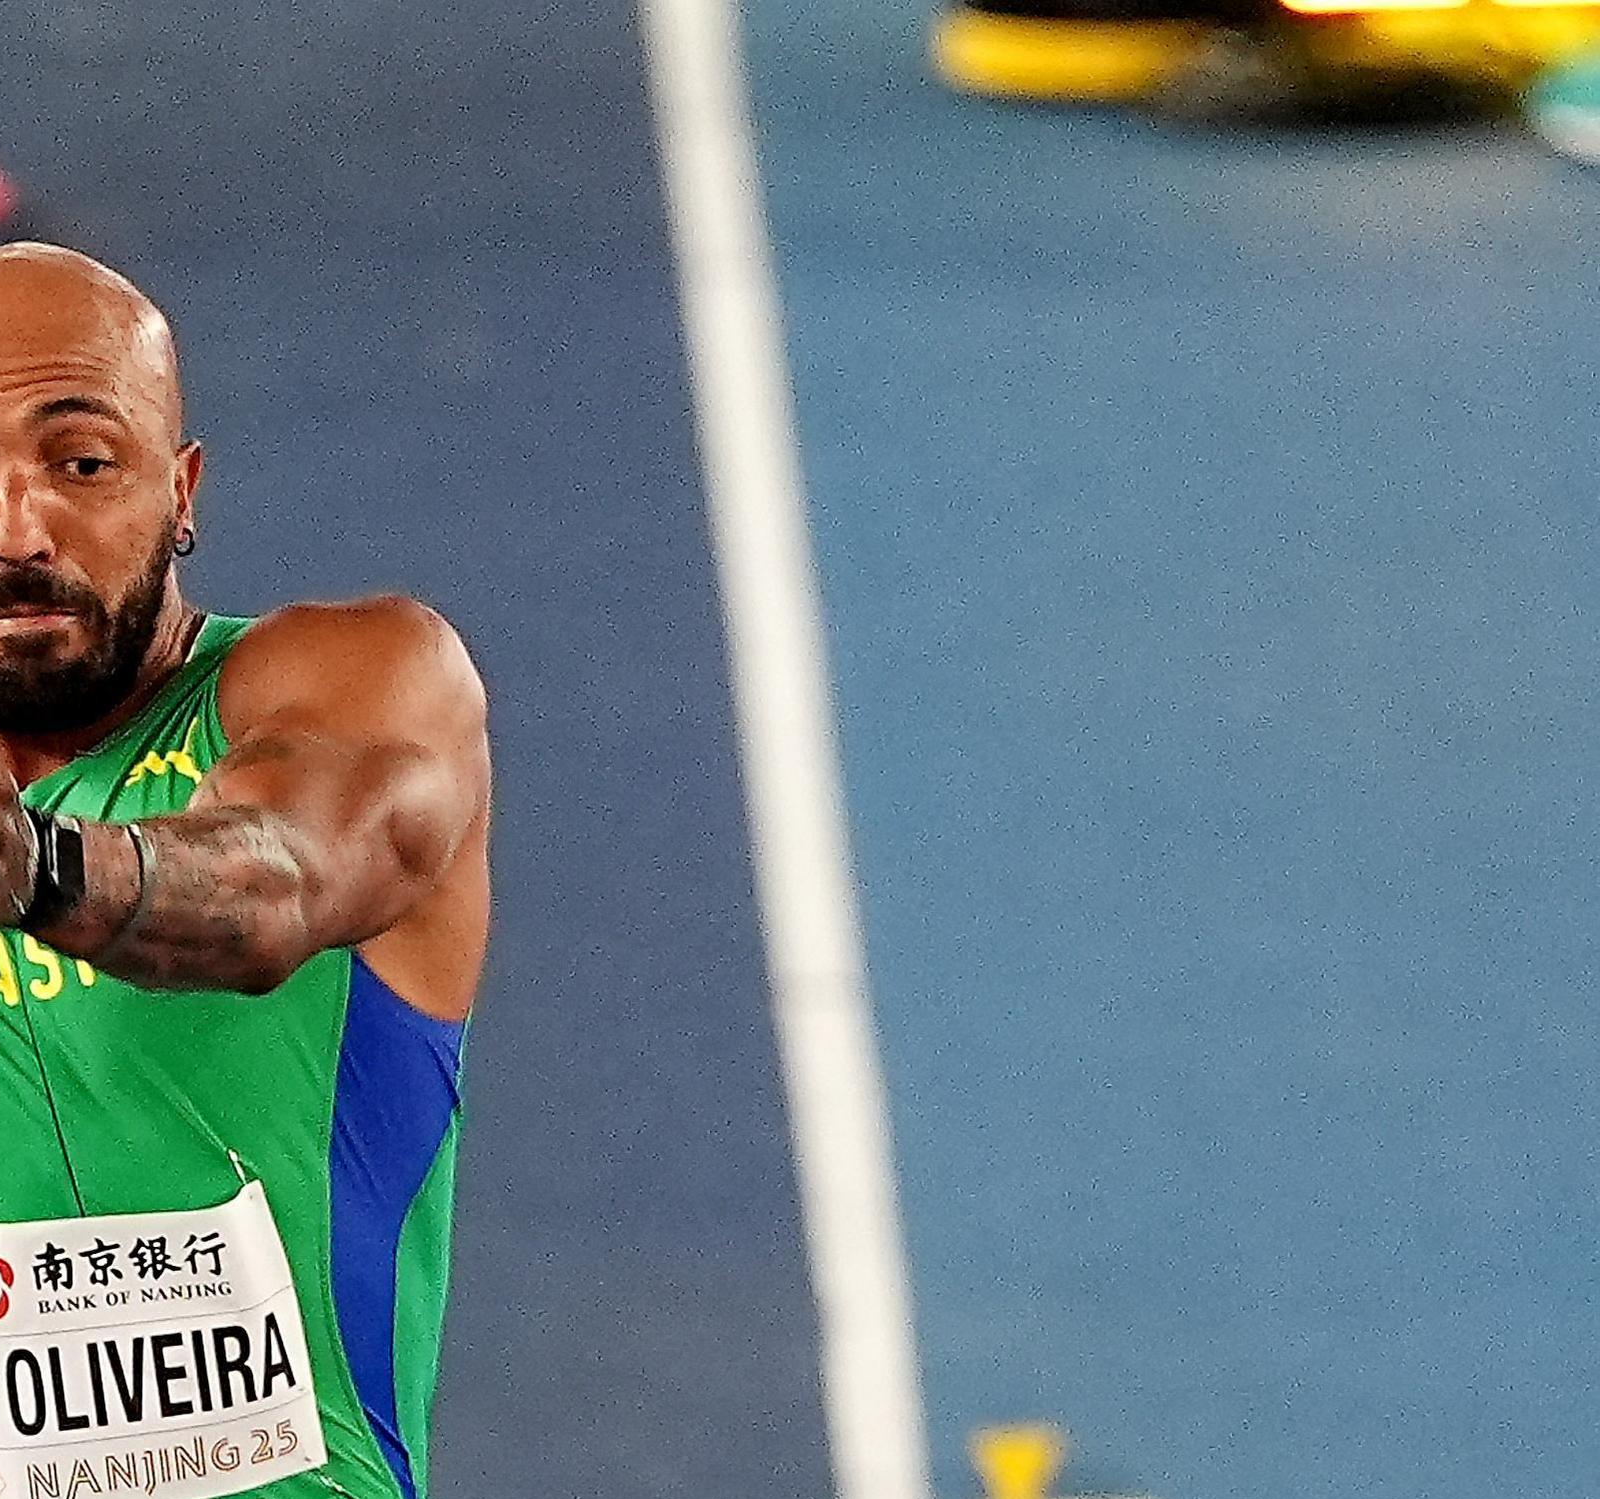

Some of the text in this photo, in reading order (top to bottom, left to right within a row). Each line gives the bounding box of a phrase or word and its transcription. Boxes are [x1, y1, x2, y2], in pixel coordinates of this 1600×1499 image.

[31, 1231, 227, 1292] 南京银行
[37, 1280, 233, 1315] BANK OF NANJING
[5, 1311, 298, 1437] OLIVEIRA
[250, 1418, 299, 1466] 25
